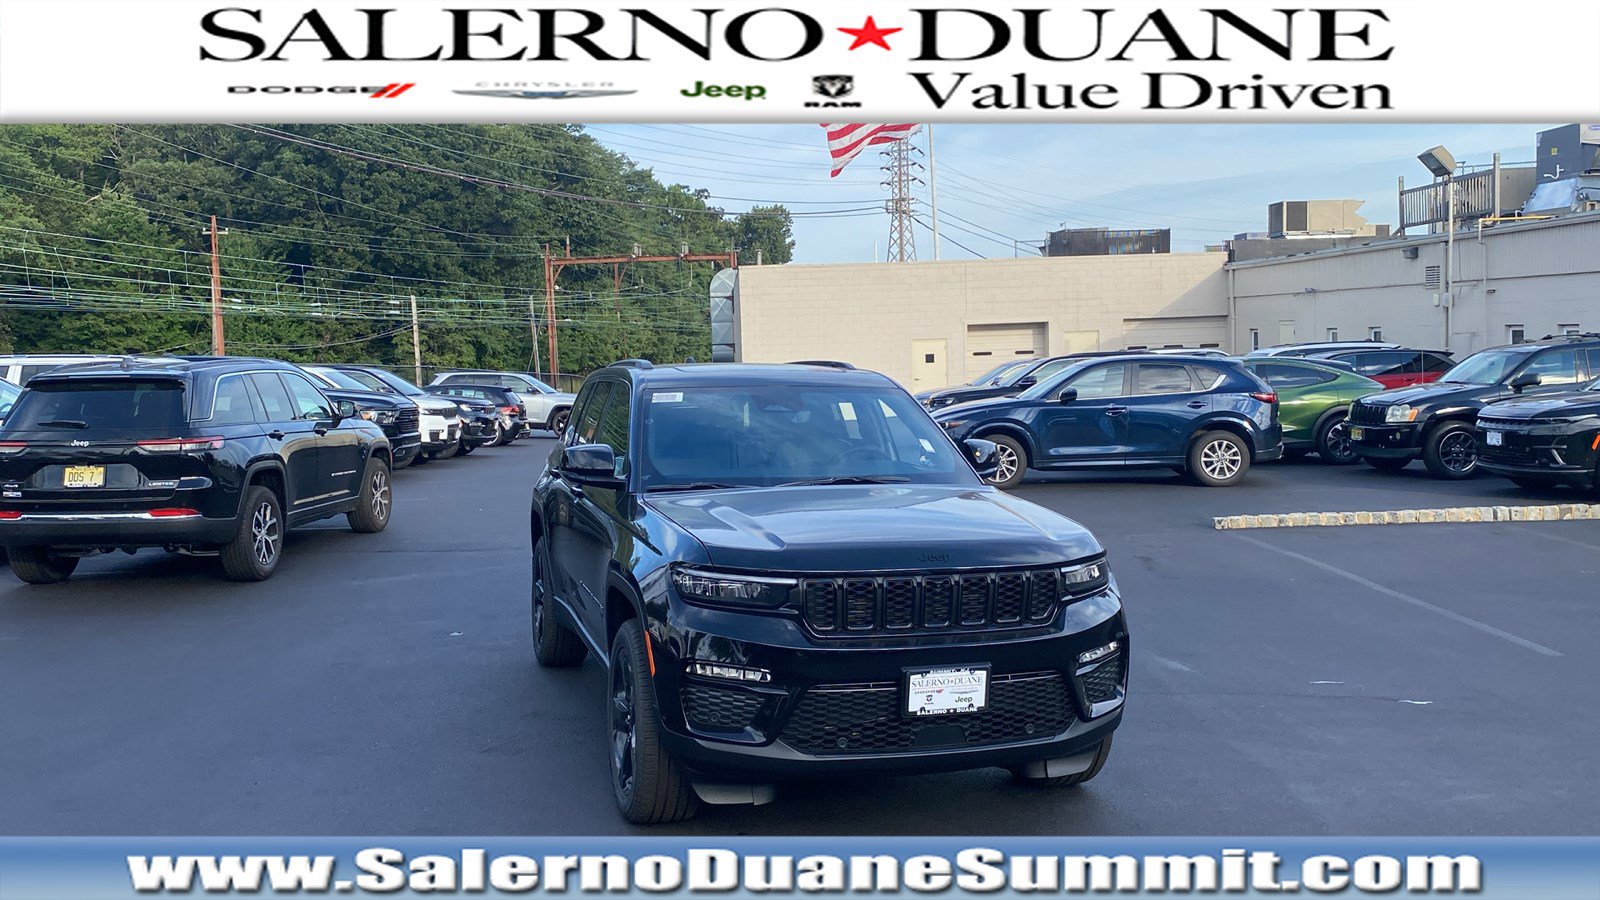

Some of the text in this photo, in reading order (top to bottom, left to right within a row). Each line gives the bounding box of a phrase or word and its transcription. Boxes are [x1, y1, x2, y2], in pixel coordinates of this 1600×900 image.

[70, 439, 89, 448] Jeep
[89, 471, 95, 482] 7
[911, 675, 984, 688] SALERNO DUANE
